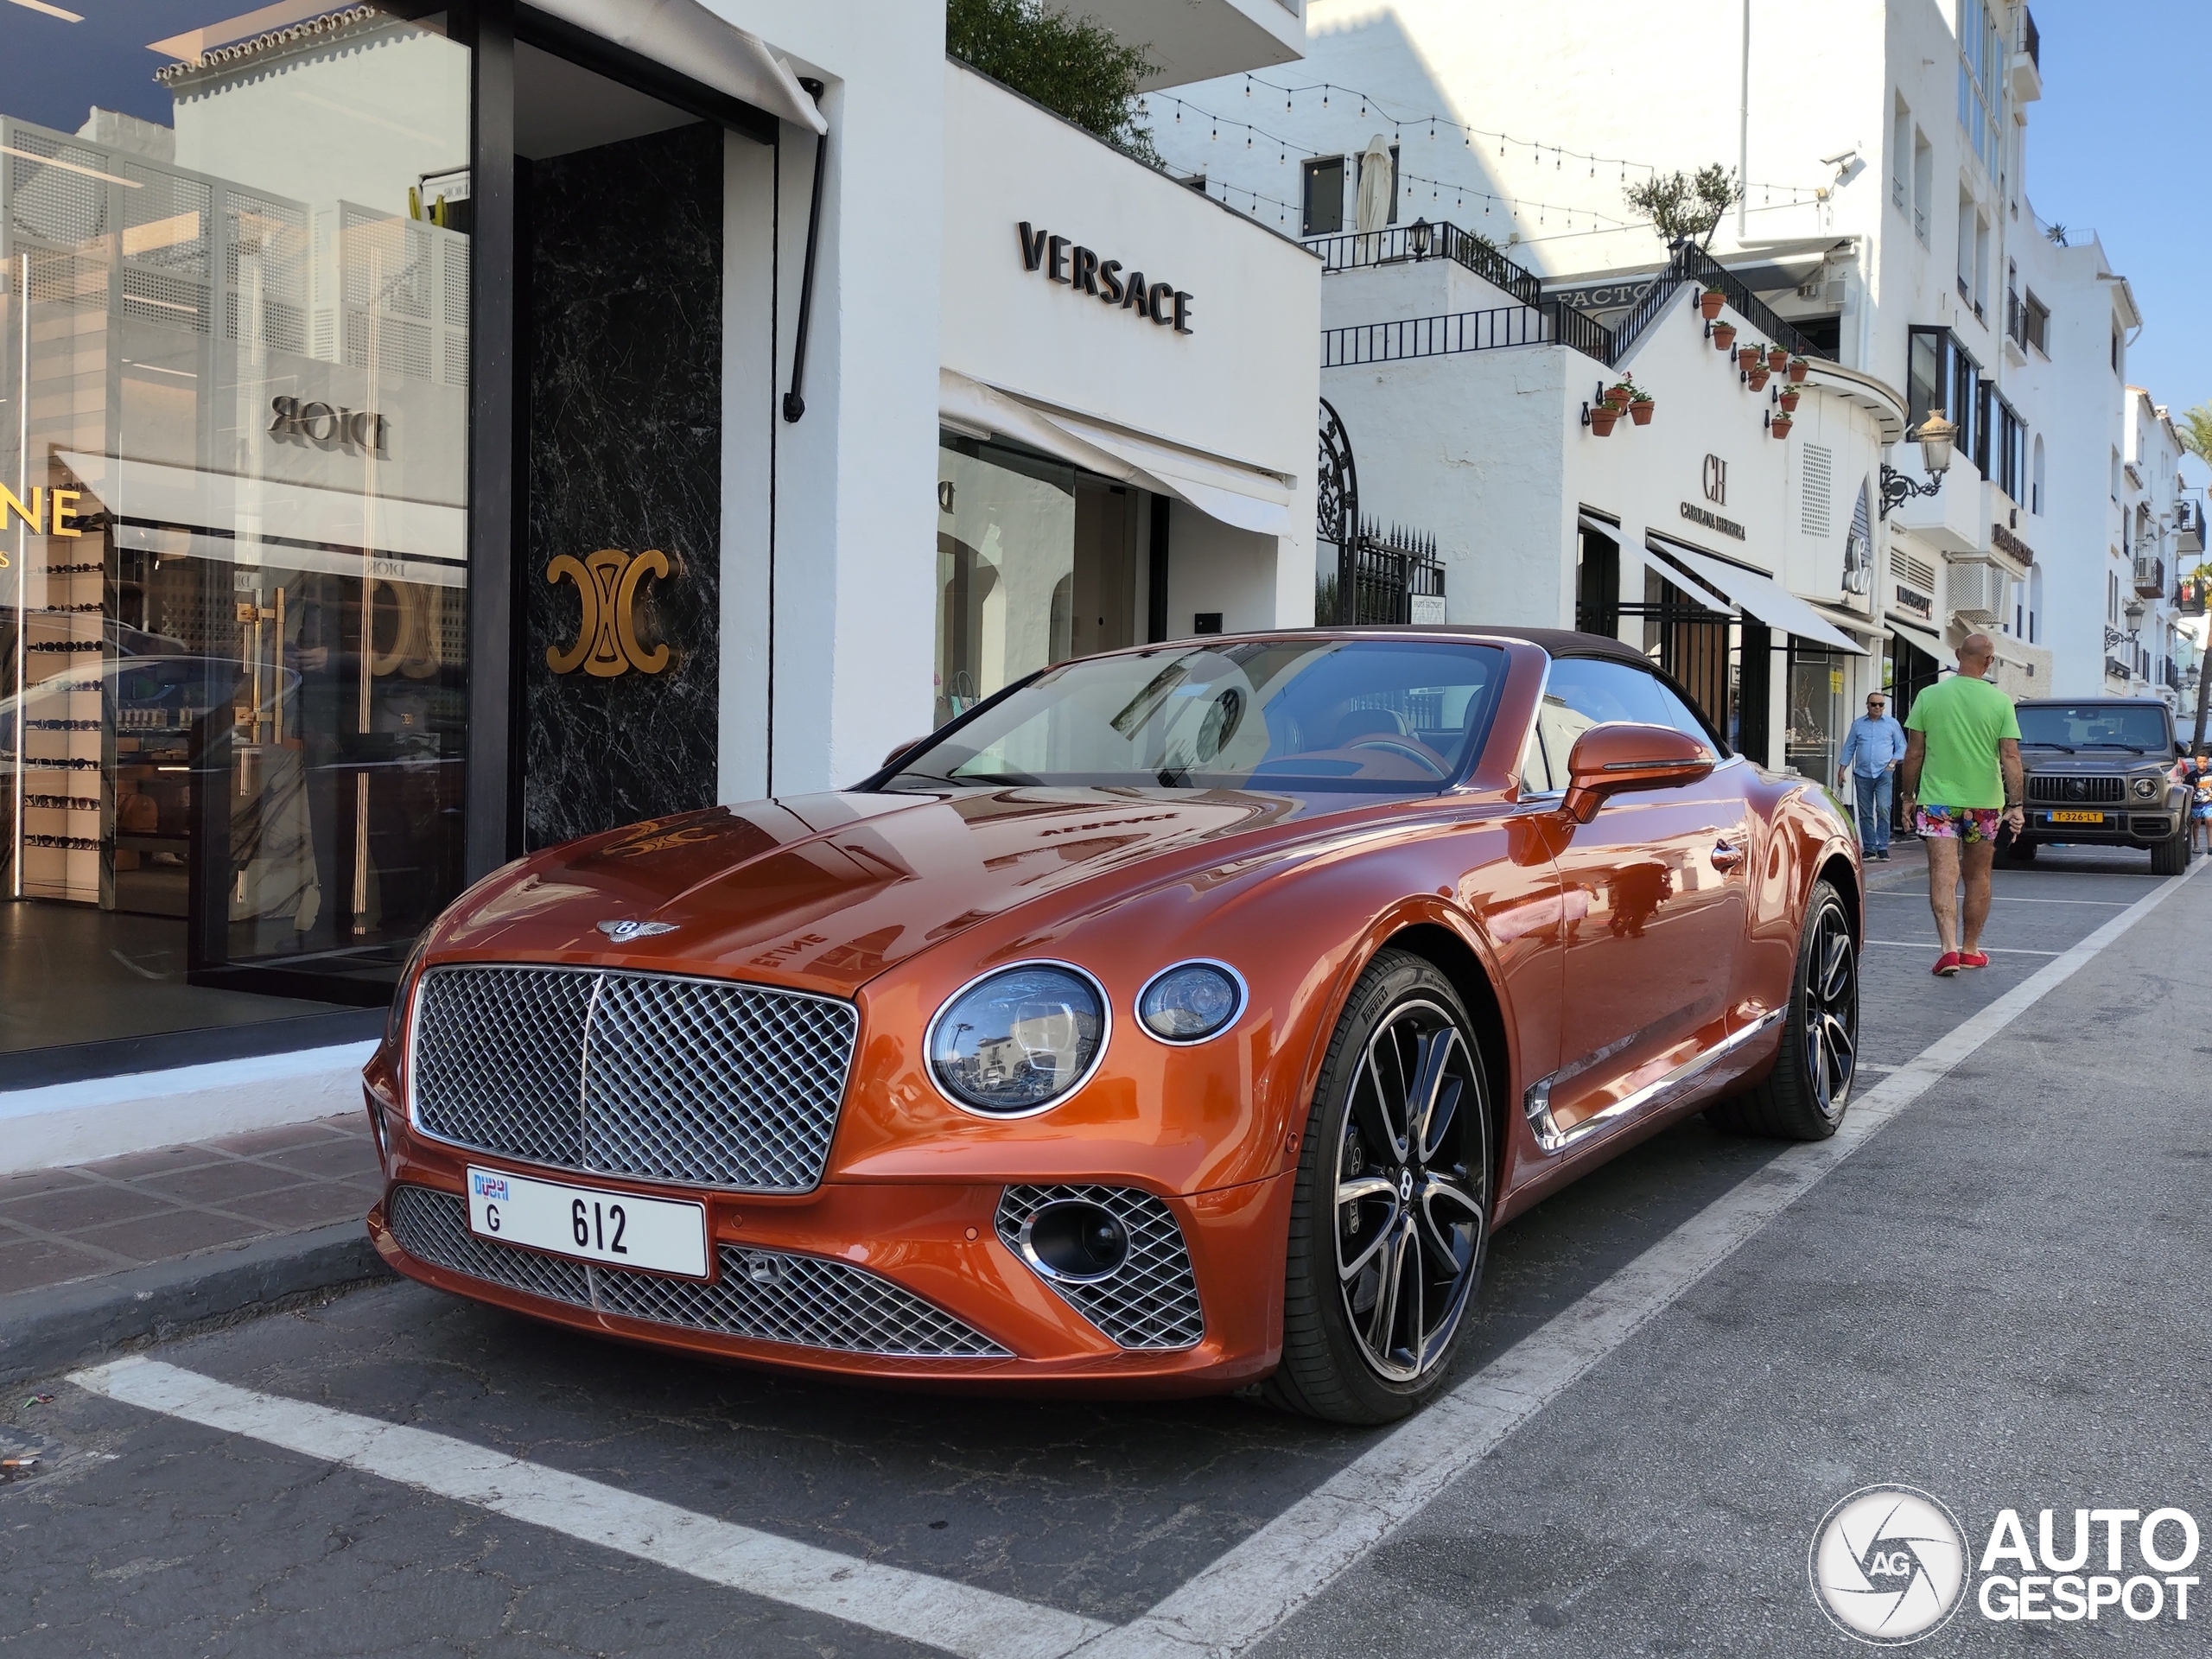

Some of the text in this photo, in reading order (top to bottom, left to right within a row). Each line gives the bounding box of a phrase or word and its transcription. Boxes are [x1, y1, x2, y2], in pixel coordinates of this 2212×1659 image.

[1015, 221, 1194, 335] VERSACE
[1702, 453, 1728, 507] CH
[1680, 501, 1746, 542] CAROLINA HERRERA
[2056, 812, 2098, 821] T-326-LT
[1361, 985, 1389, 1026] PIRELLI
[486, 1204, 500, 1232] G
[572, 1198, 627, 1255] 612
